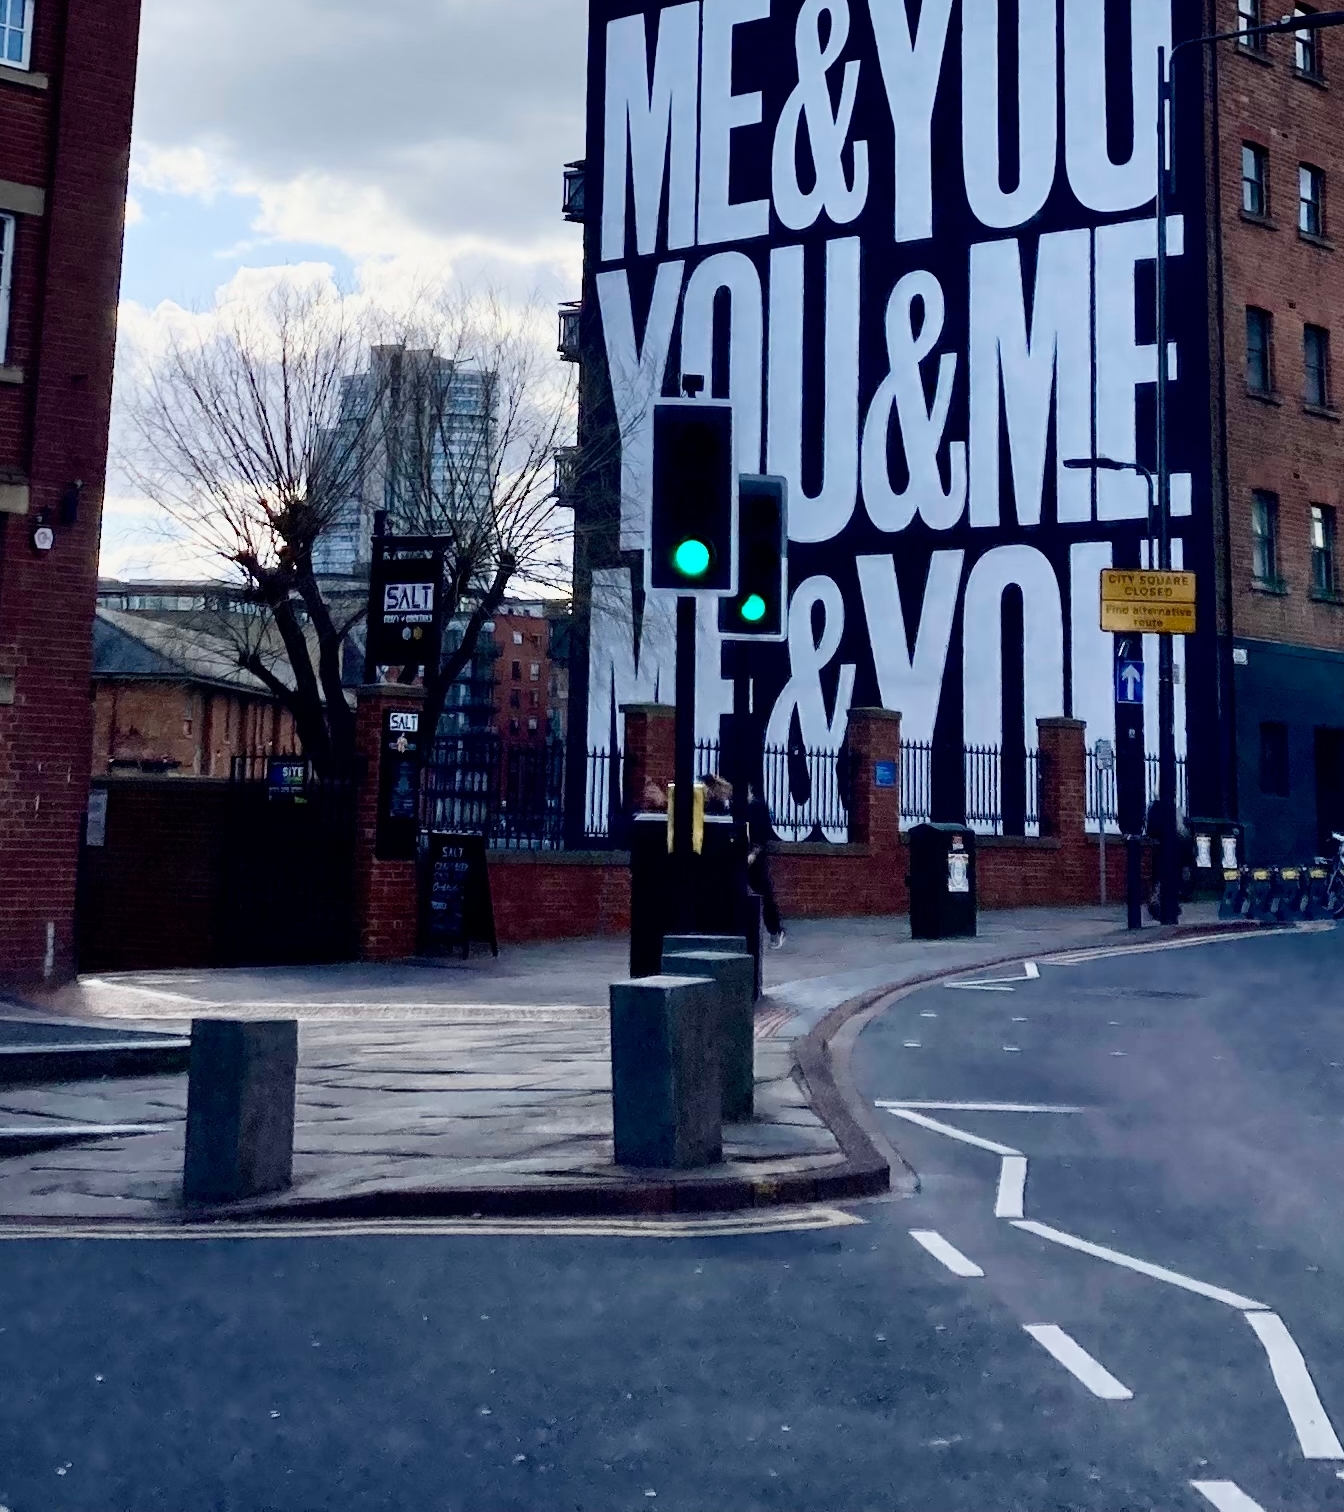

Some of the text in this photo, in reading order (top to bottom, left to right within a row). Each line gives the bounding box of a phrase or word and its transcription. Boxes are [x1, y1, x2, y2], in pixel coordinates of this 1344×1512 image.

[1108, 574, 1189, 587] CITY SQUARE
[386, 585, 433, 610] SALT
[1124, 586, 1173, 598] CLOSED
[1105, 603, 1192, 617] Find alternative
[1133, 618, 1164, 629] route
[391, 714, 418, 730] SALT
